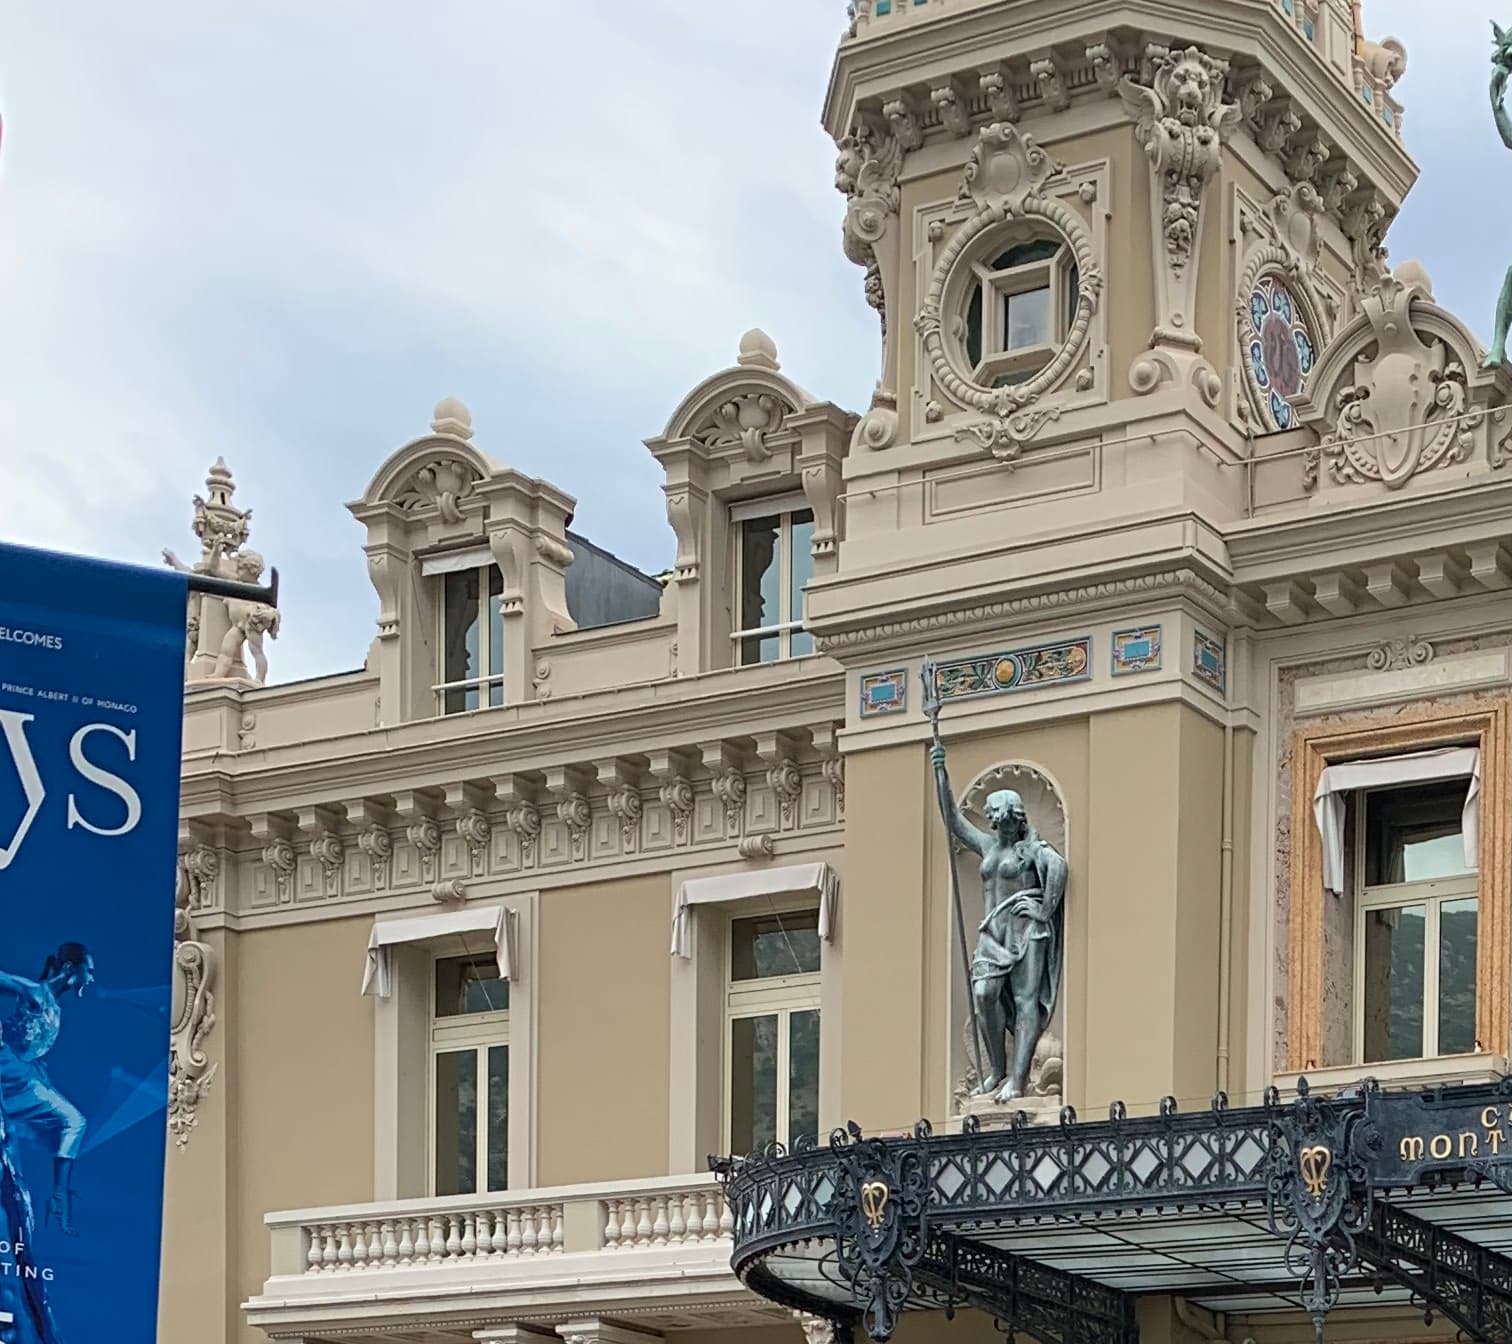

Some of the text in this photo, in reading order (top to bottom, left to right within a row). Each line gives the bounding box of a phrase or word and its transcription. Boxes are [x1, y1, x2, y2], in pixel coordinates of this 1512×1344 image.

[0, 627, 63, 650] ELCOMES
[2, 683, 34, 696] PRINCE
[37, 690, 68, 701] ALBERT
[81, 697, 94, 705] OF
[97, 699, 138, 714] MONACO
[0, 1262, 54, 1281] TING
